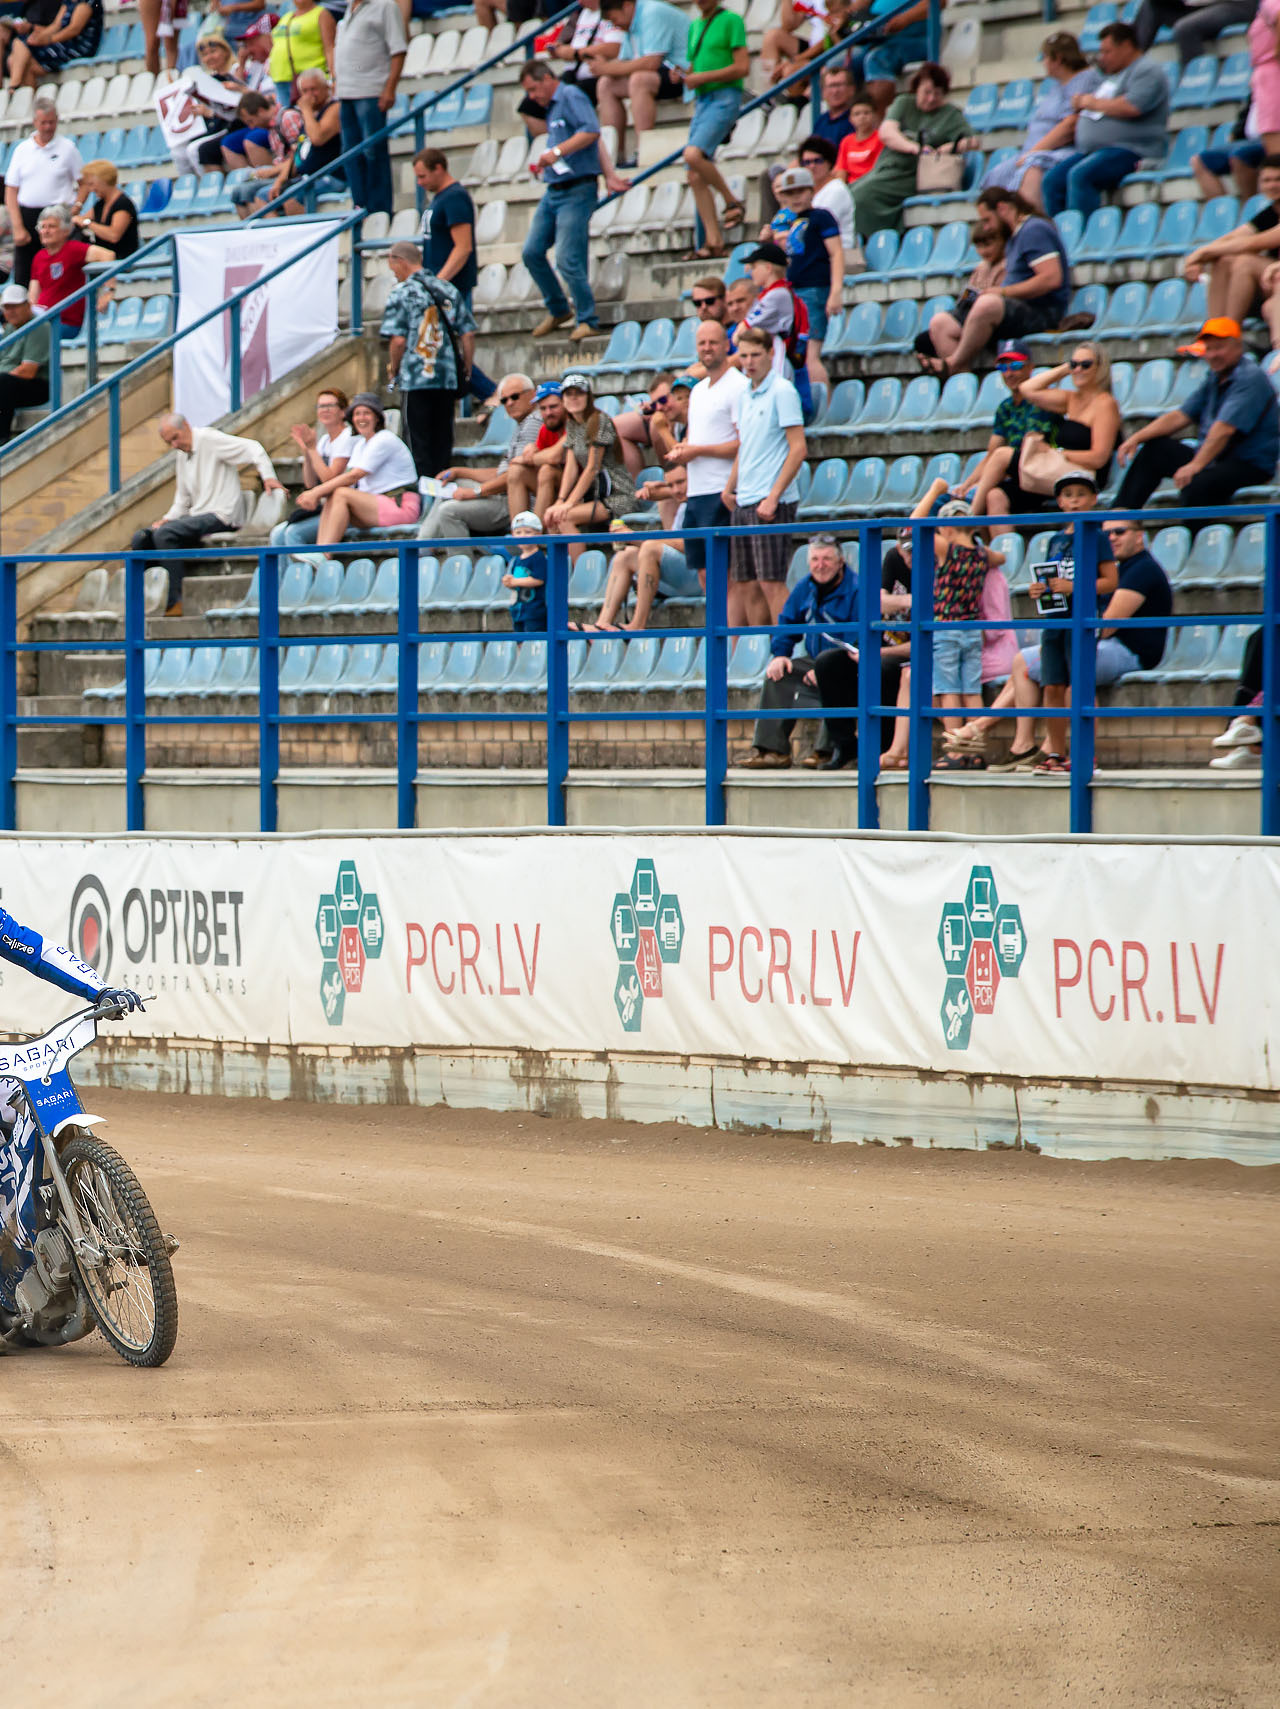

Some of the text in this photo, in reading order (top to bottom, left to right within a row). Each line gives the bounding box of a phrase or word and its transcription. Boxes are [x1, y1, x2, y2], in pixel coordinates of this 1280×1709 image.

[122, 887, 244, 967] OPTIBET
[406, 922, 541, 996] PCR.LV
[708, 925, 862, 1008] PCR.LV
[123, 974, 192, 993] SPORTA
[344, 967, 361, 985] PCR
[643, 971, 662, 990] PCR
[1053, 938, 1225, 1025] PCR.LV
[973, 986, 994, 1006] PCR
[23, 1057, 59, 1072] SPORTS
[36, 1089, 74, 1107] SAGARI
